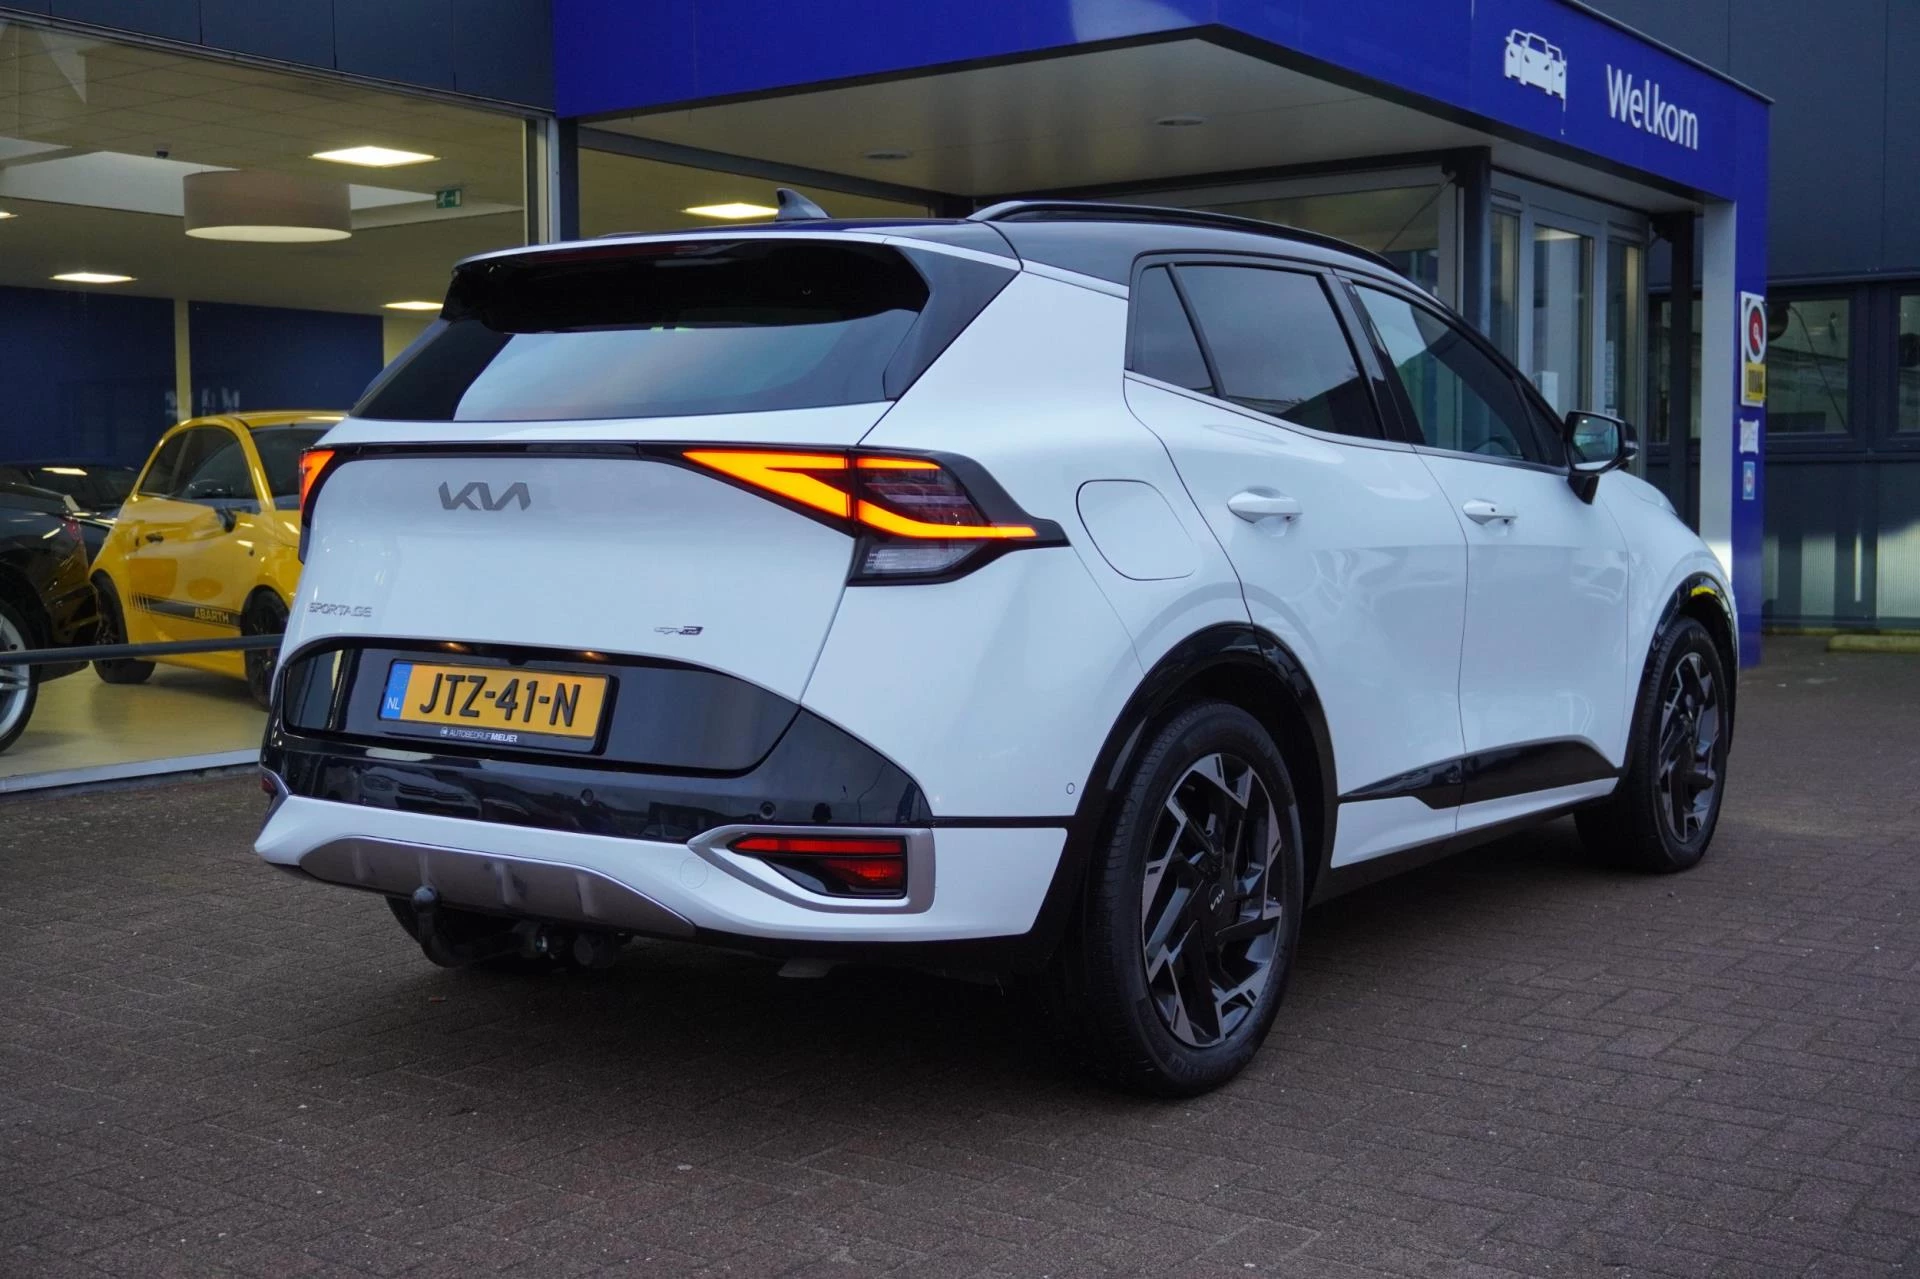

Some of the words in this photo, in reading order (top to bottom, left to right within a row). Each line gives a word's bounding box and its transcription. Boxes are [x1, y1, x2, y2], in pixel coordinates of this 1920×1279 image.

[1606, 64, 1698, 151] Welkom
[439, 481, 531, 511] KIA
[194, 607, 230, 624] ABARTH
[309, 602, 373, 618] SPORTAGE
[386, 697, 401, 711] NL
[419, 673, 582, 727] JTZ-41-N
